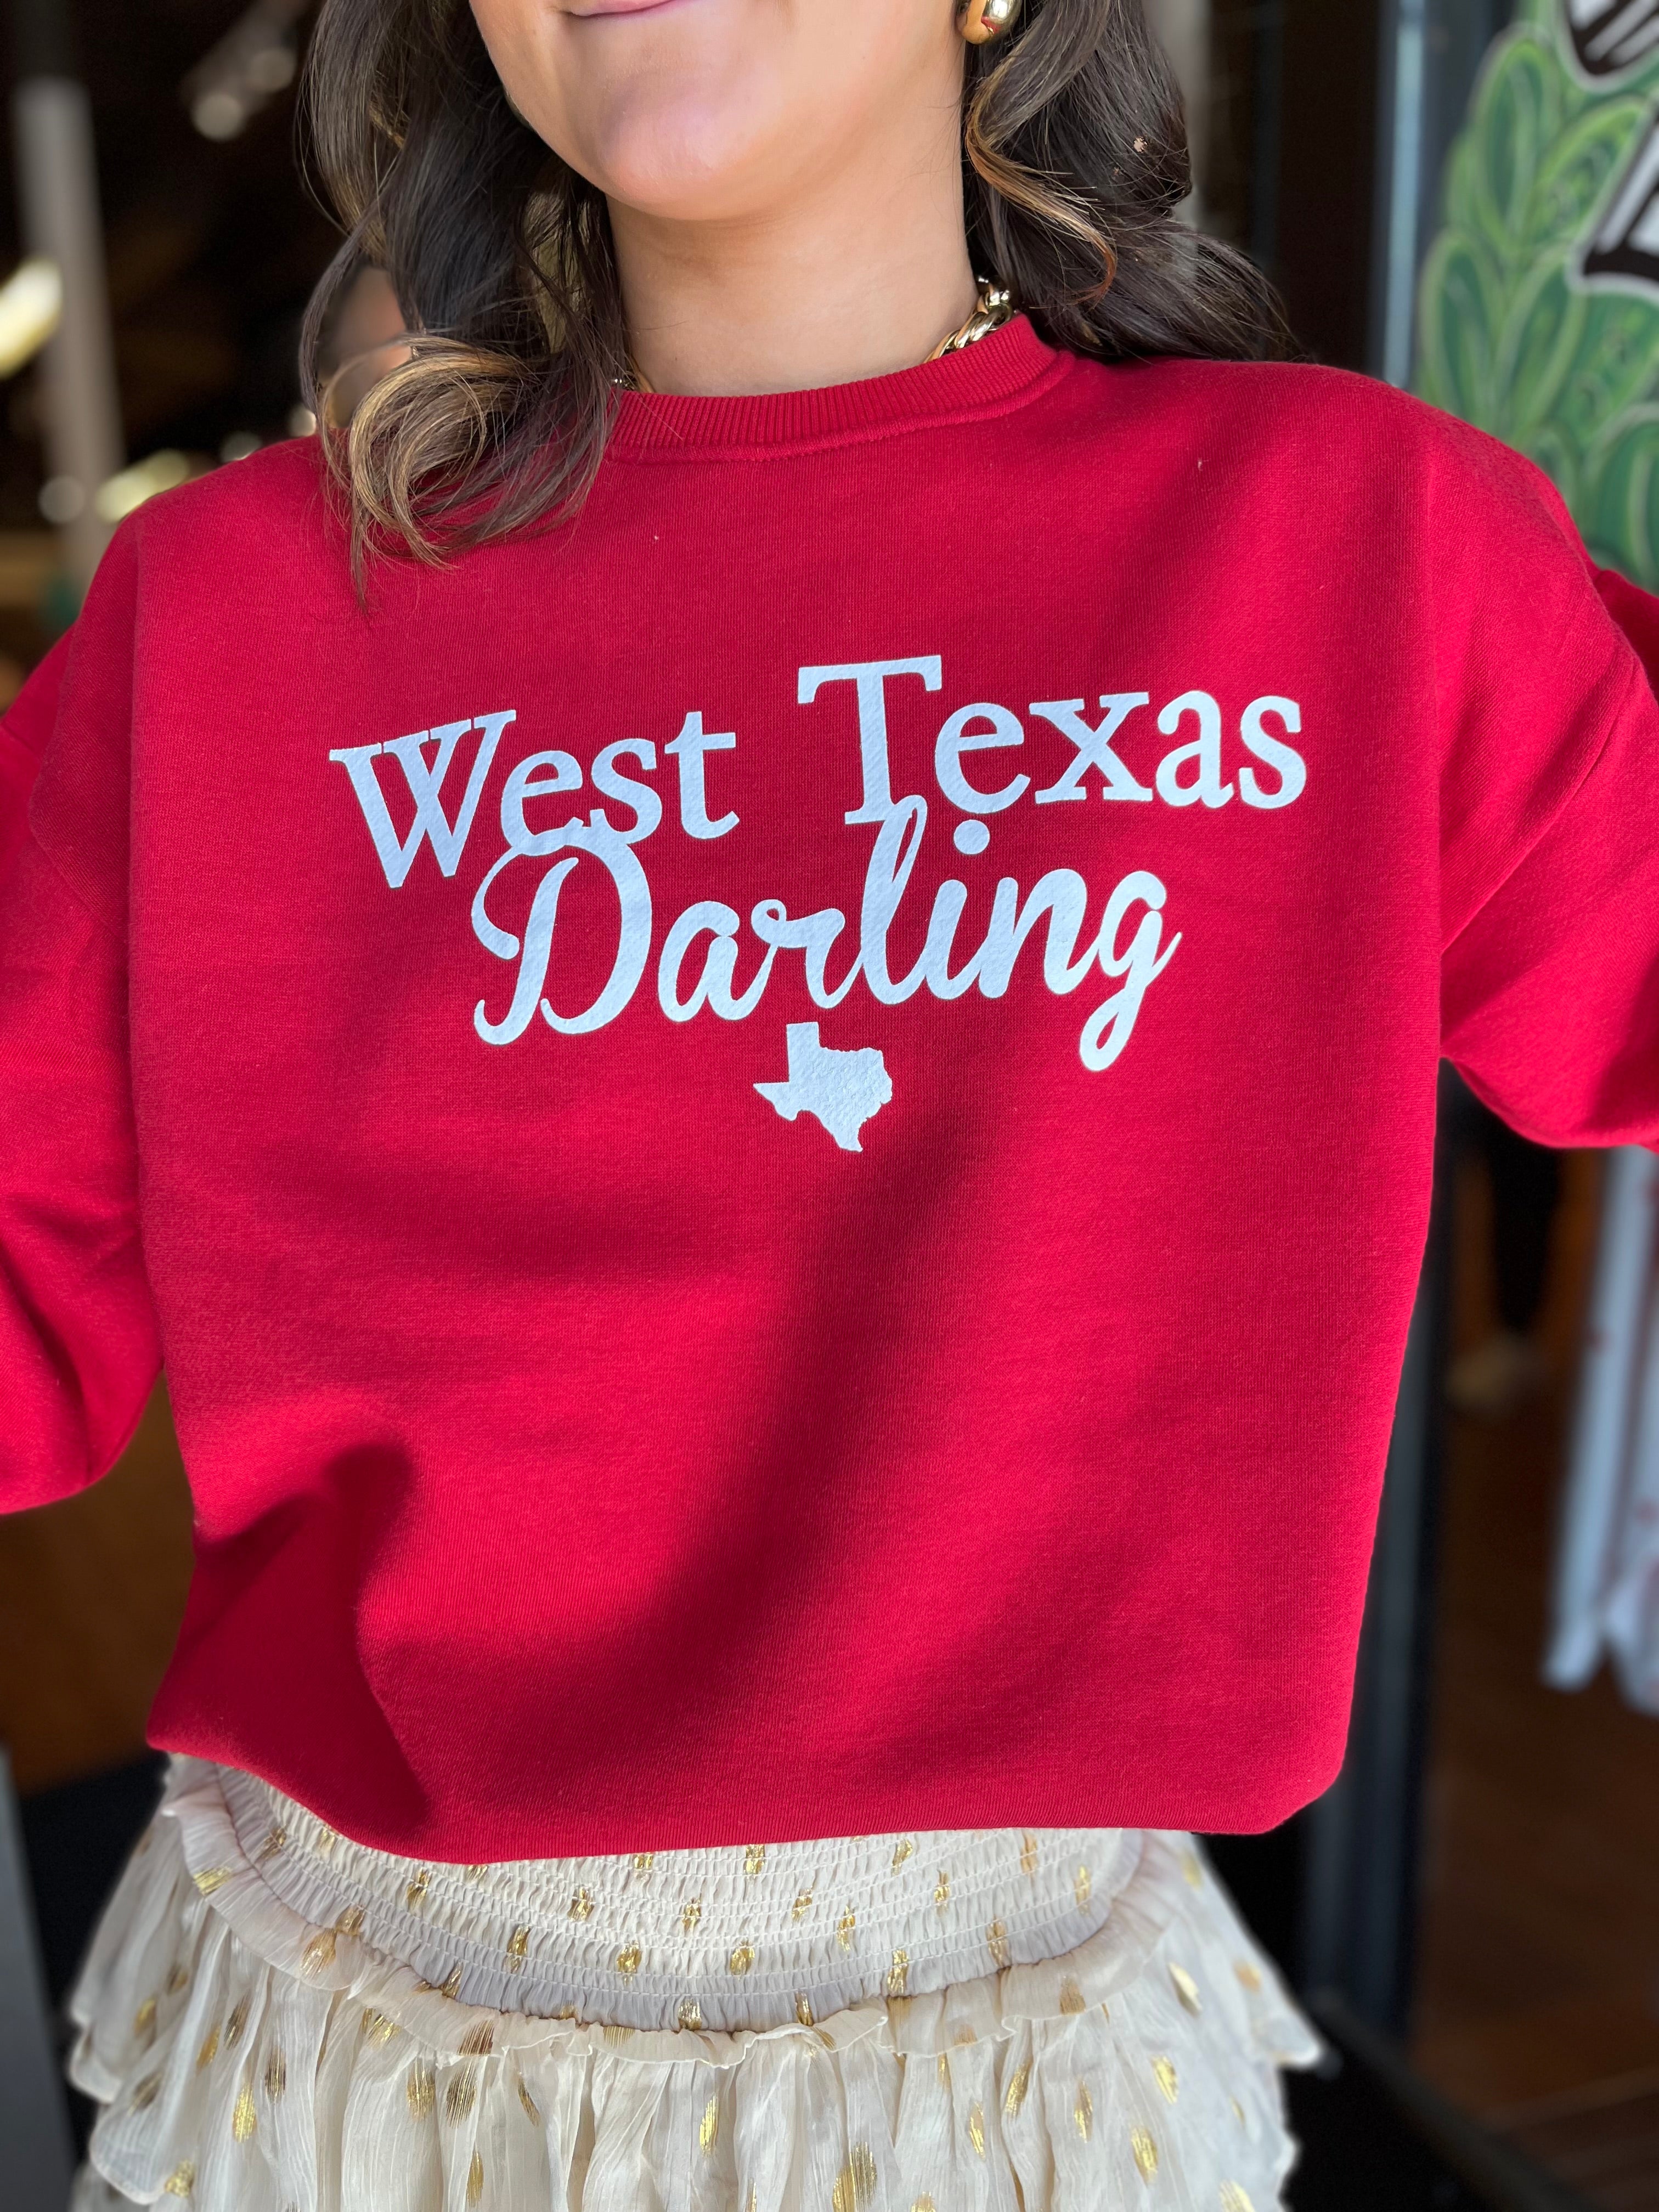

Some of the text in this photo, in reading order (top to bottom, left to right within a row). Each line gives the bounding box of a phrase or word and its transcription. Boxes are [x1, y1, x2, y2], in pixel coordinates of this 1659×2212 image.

[329, 654, 1307, 889] West Texas
[471, 795, 1182, 1072] Darling
